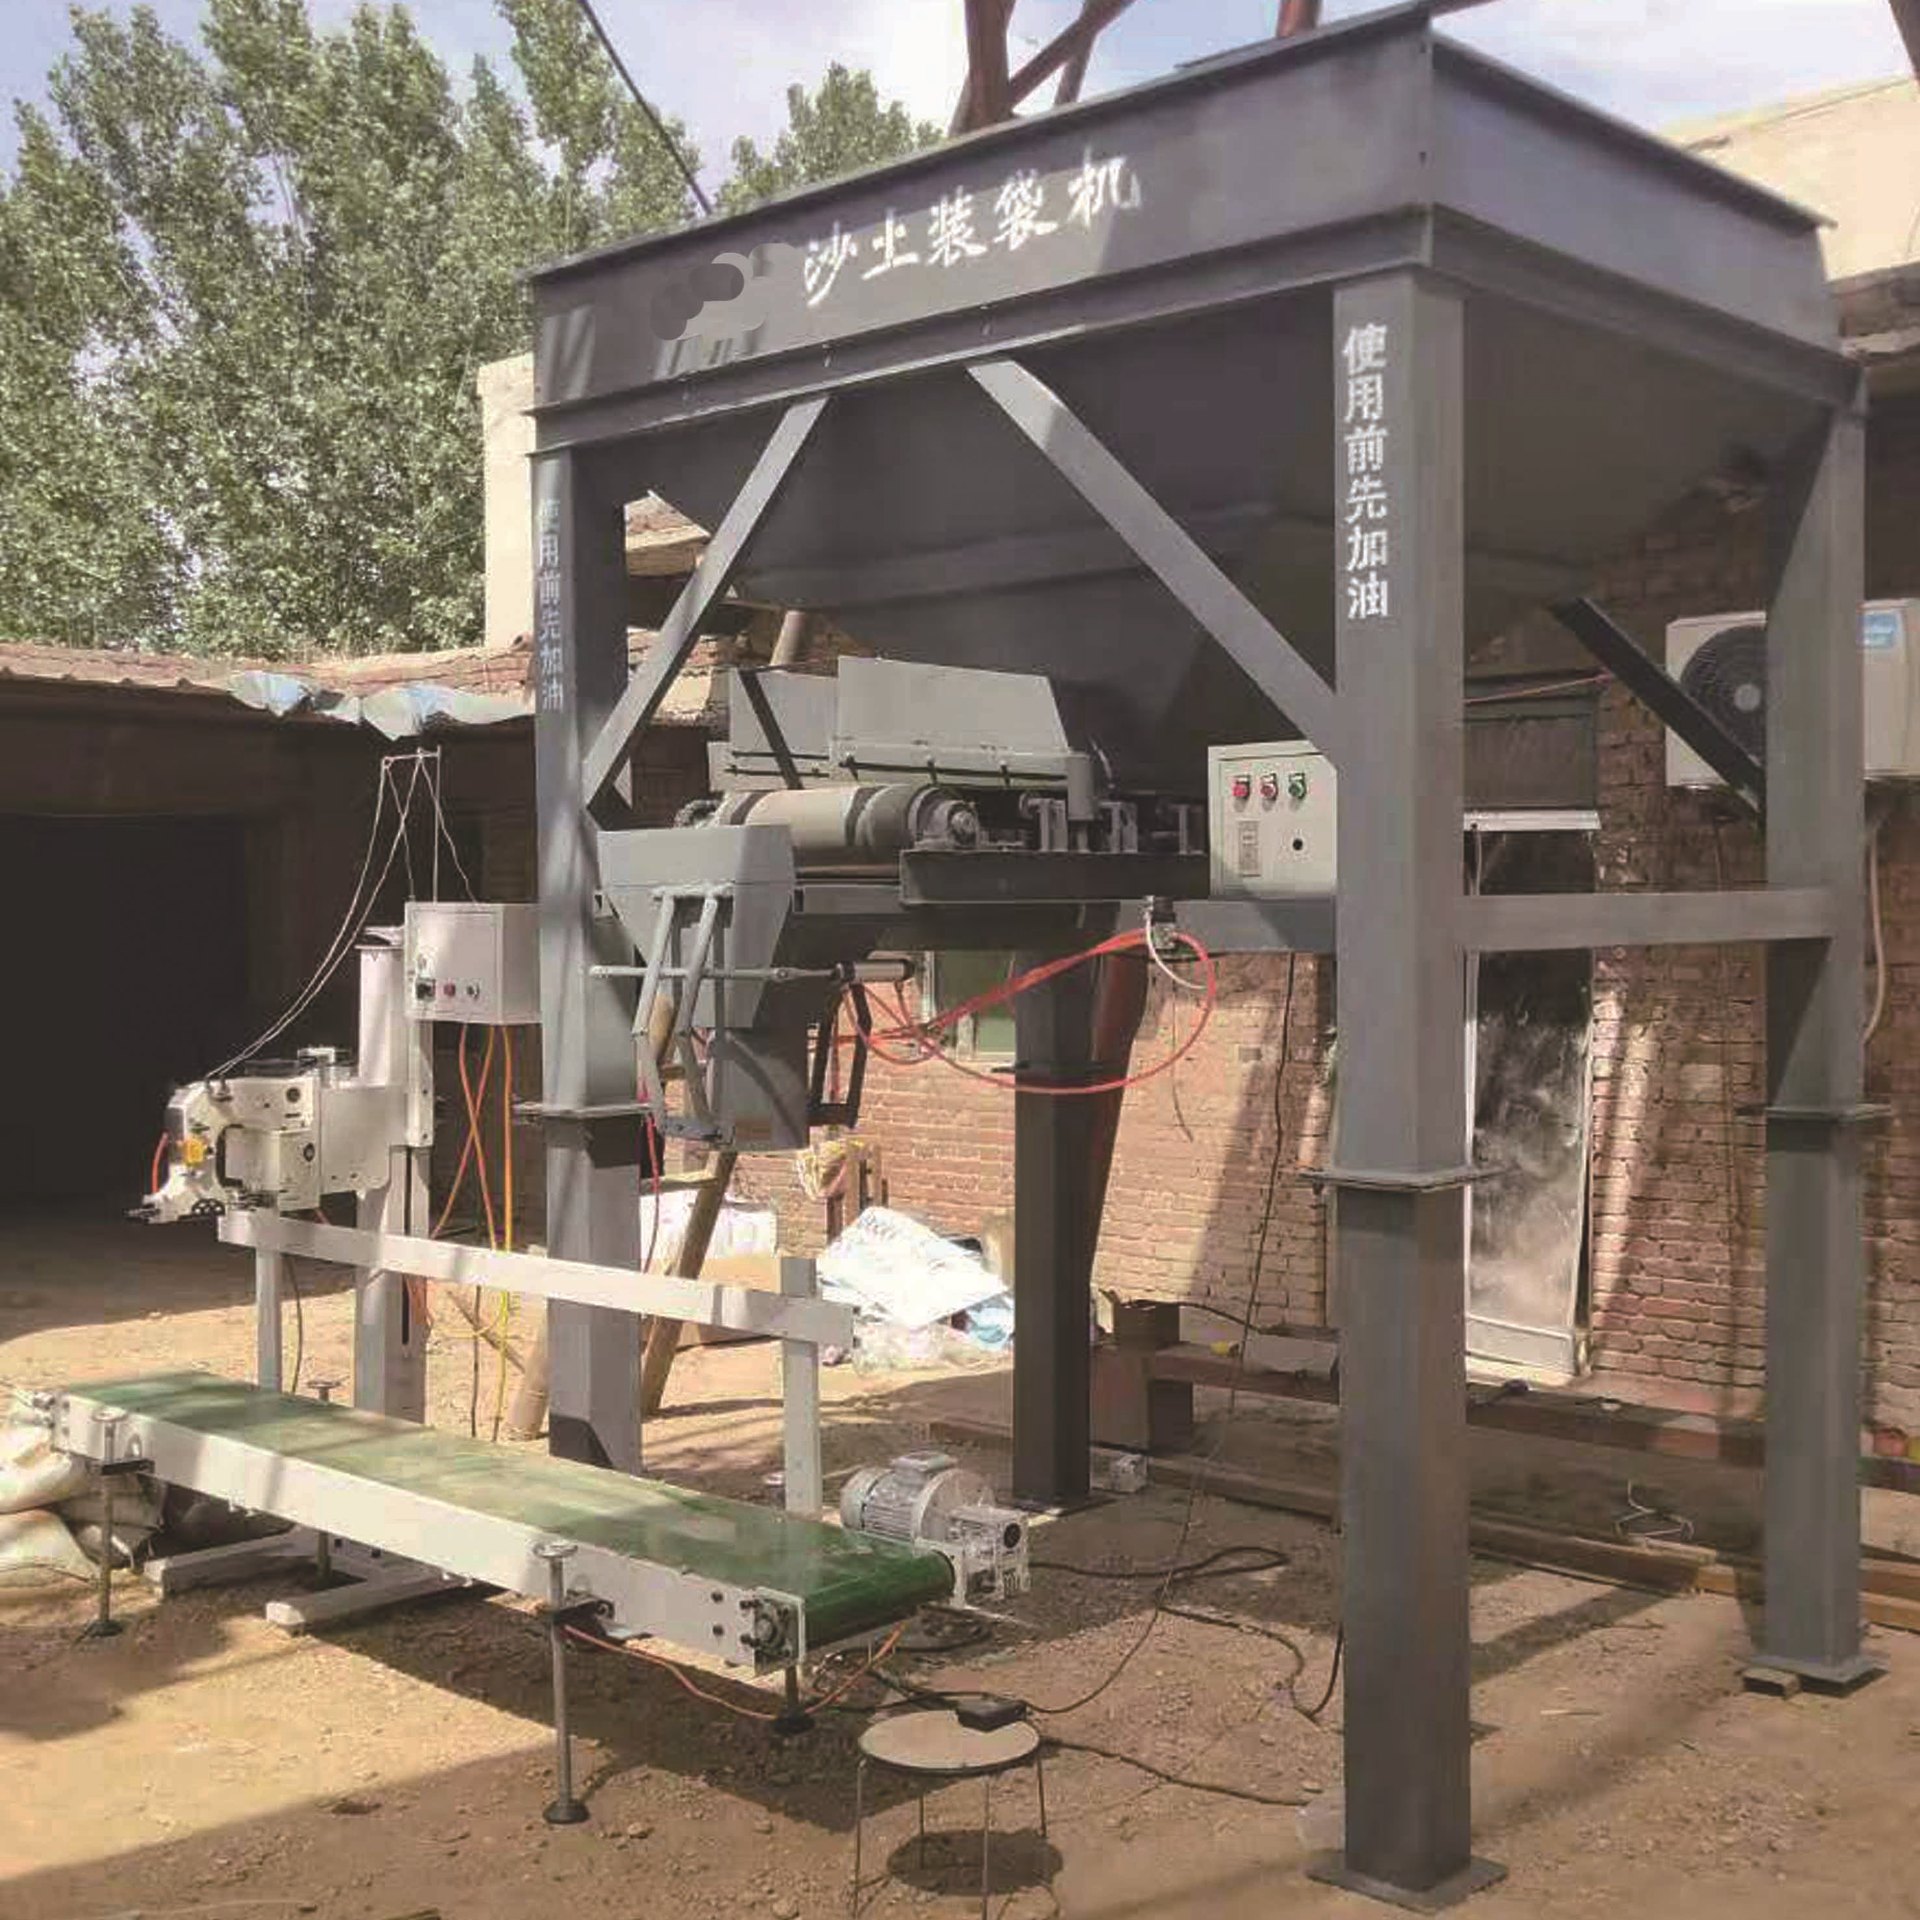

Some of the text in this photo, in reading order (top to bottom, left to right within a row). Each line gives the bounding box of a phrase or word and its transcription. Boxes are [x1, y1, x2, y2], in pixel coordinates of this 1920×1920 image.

[803, 148, 1142, 307] 沙土装袋机
[1342, 322, 1389, 620] 使用前先加油
